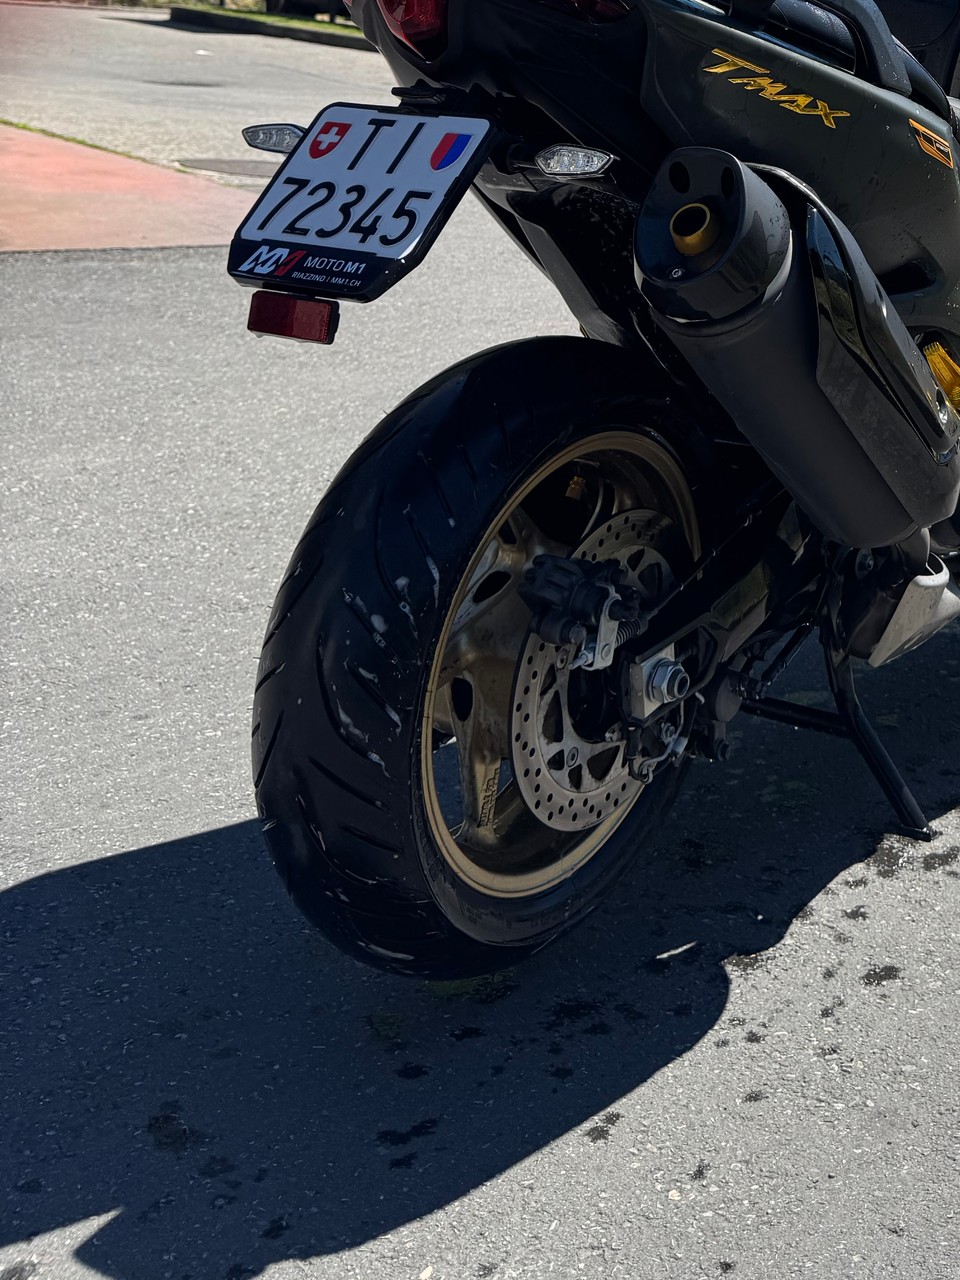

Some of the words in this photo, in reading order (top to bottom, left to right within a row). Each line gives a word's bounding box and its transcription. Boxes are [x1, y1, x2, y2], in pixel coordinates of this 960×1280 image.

[347, 118, 426, 174] TI
[257, 176, 436, 246] 72345
[291, 271, 327, 282] RIAZZINO
[330, 276, 362, 287] MM1.CH
